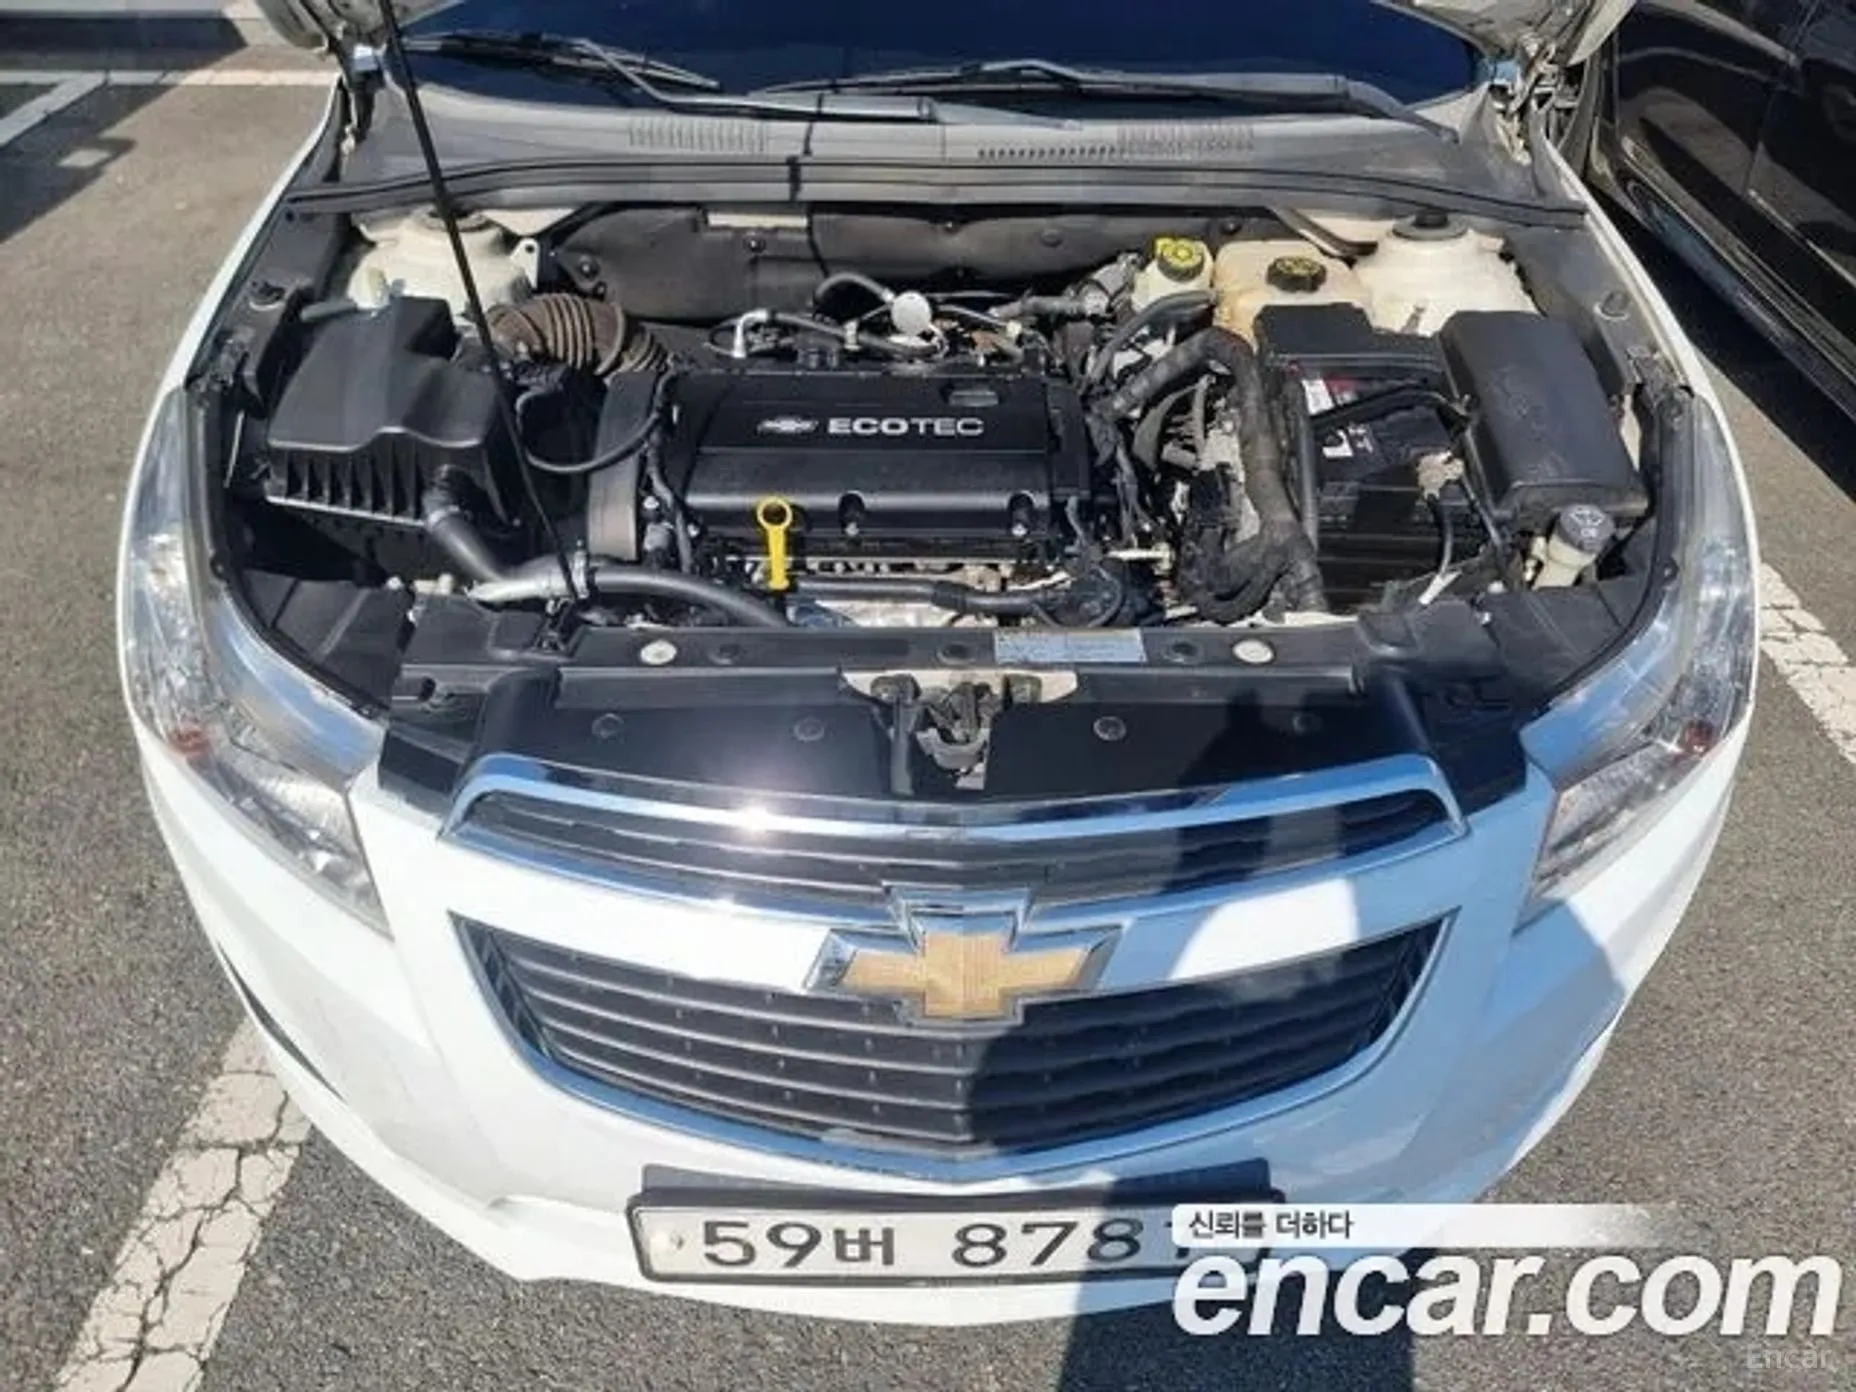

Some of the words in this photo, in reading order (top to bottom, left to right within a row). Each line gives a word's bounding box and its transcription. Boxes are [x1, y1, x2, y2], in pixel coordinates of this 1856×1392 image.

[827, 417, 985, 436] ECOTEC
[703, 1220, 895, 1267] 59버
[951, 1217, 1191, 1267] 878
